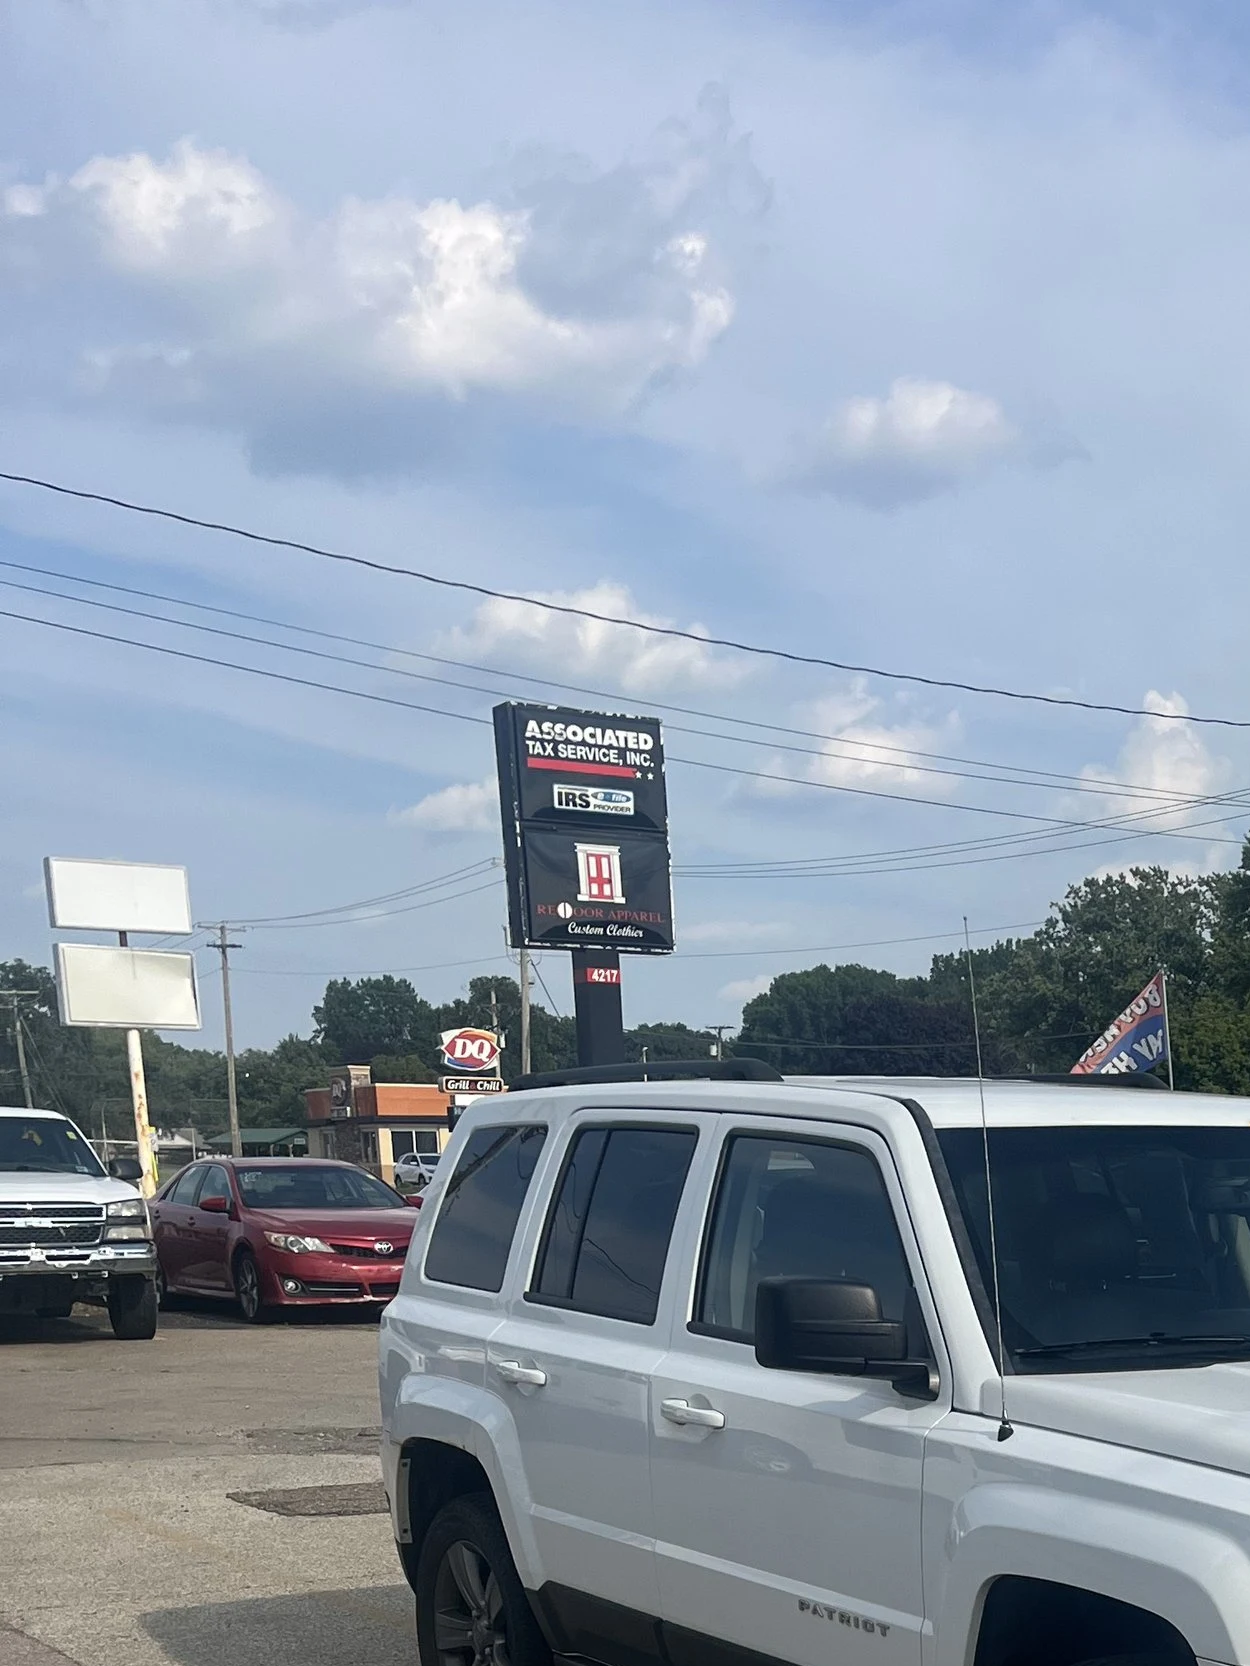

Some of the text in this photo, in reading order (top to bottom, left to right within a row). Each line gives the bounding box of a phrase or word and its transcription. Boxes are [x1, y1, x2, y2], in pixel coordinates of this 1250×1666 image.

[525, 719, 654, 750] ASSOCIATED
[525, 740, 655, 768] TAX SERVICE, INC.
[557, 791, 591, 809] IRS
[593, 803, 631, 813] PROVIDER
[608, 909, 665, 923] APPAREL
[567, 921, 644, 938] Custom Clothier
[591, 968, 618, 983] 4217
[453, 1038, 492, 1063] DQ
[447, 1079, 470, 1091] Grill
[476, 1080, 500, 1091] Chill
[798, 1598, 891, 1638] PATRIOT
